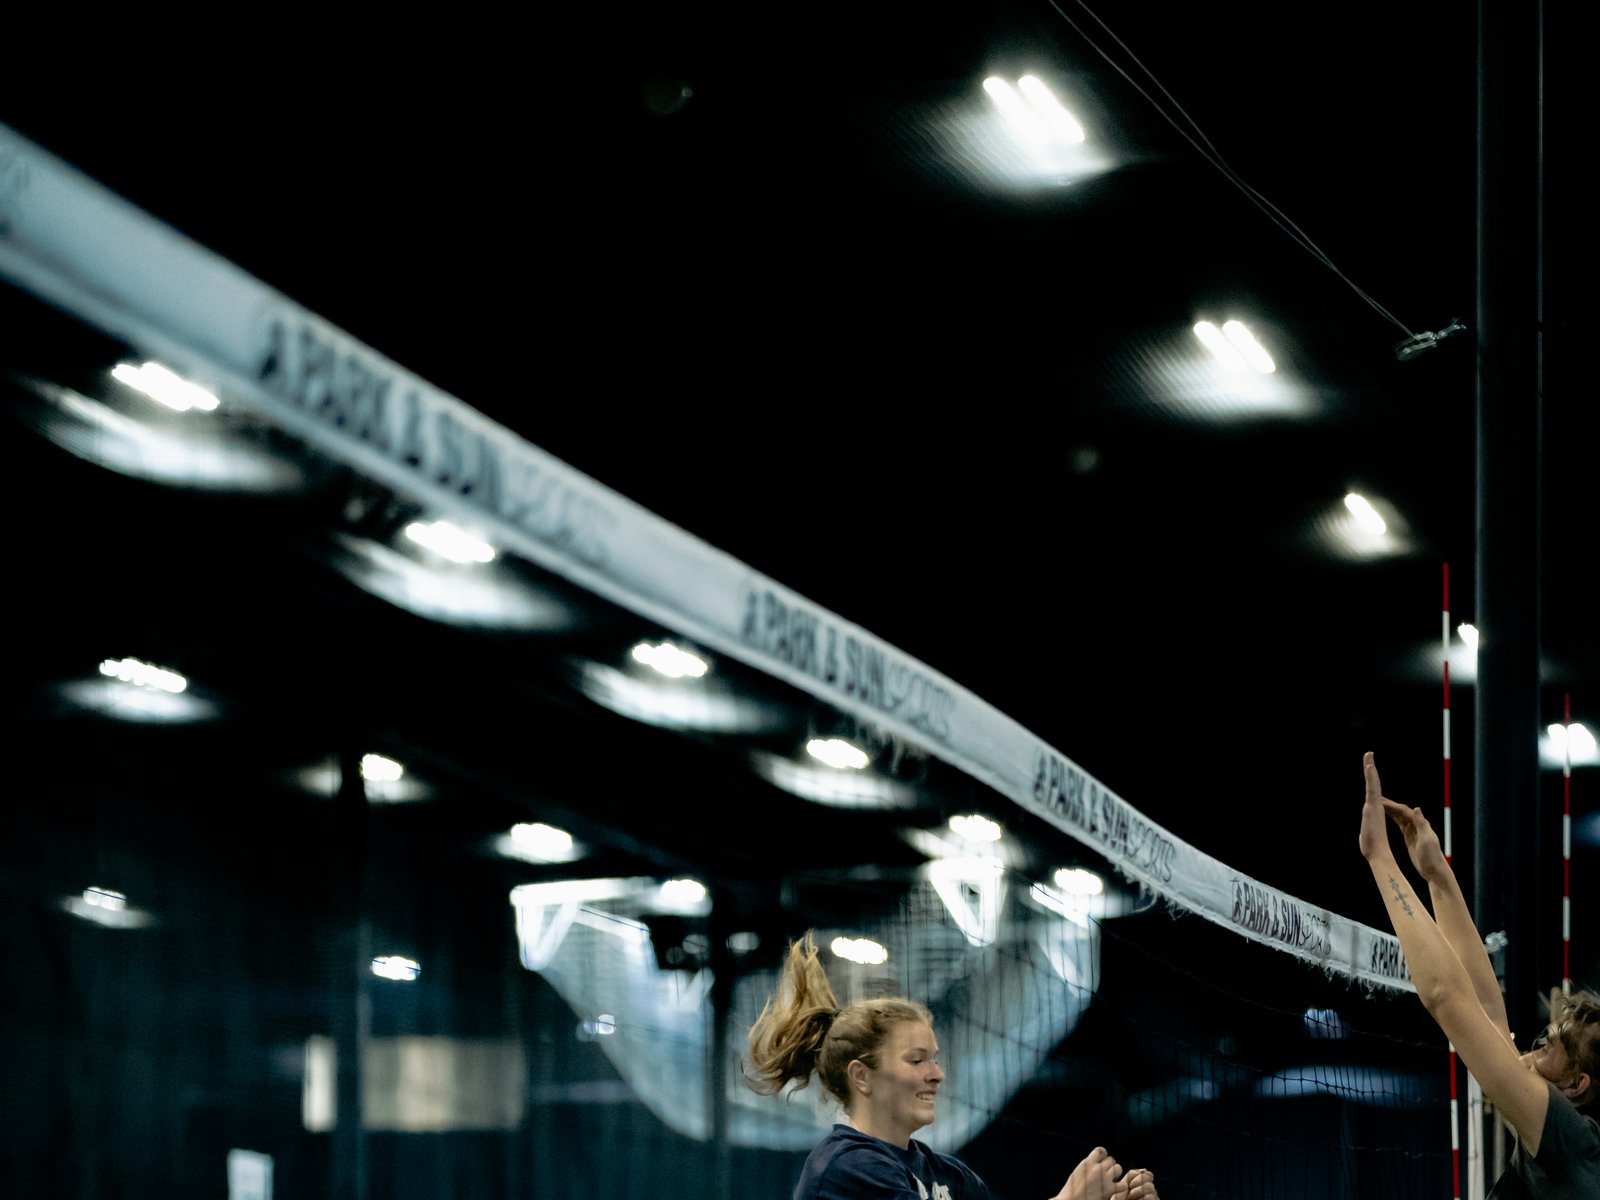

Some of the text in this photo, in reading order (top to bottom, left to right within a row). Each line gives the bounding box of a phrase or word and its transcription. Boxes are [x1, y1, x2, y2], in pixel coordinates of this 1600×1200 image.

[1241, 882, 1270, 936] PARK
[1271, 895, 1280, 937] &
[1280, 899, 1301, 946] SUN
[1378, 937, 1400, 979] PARK
